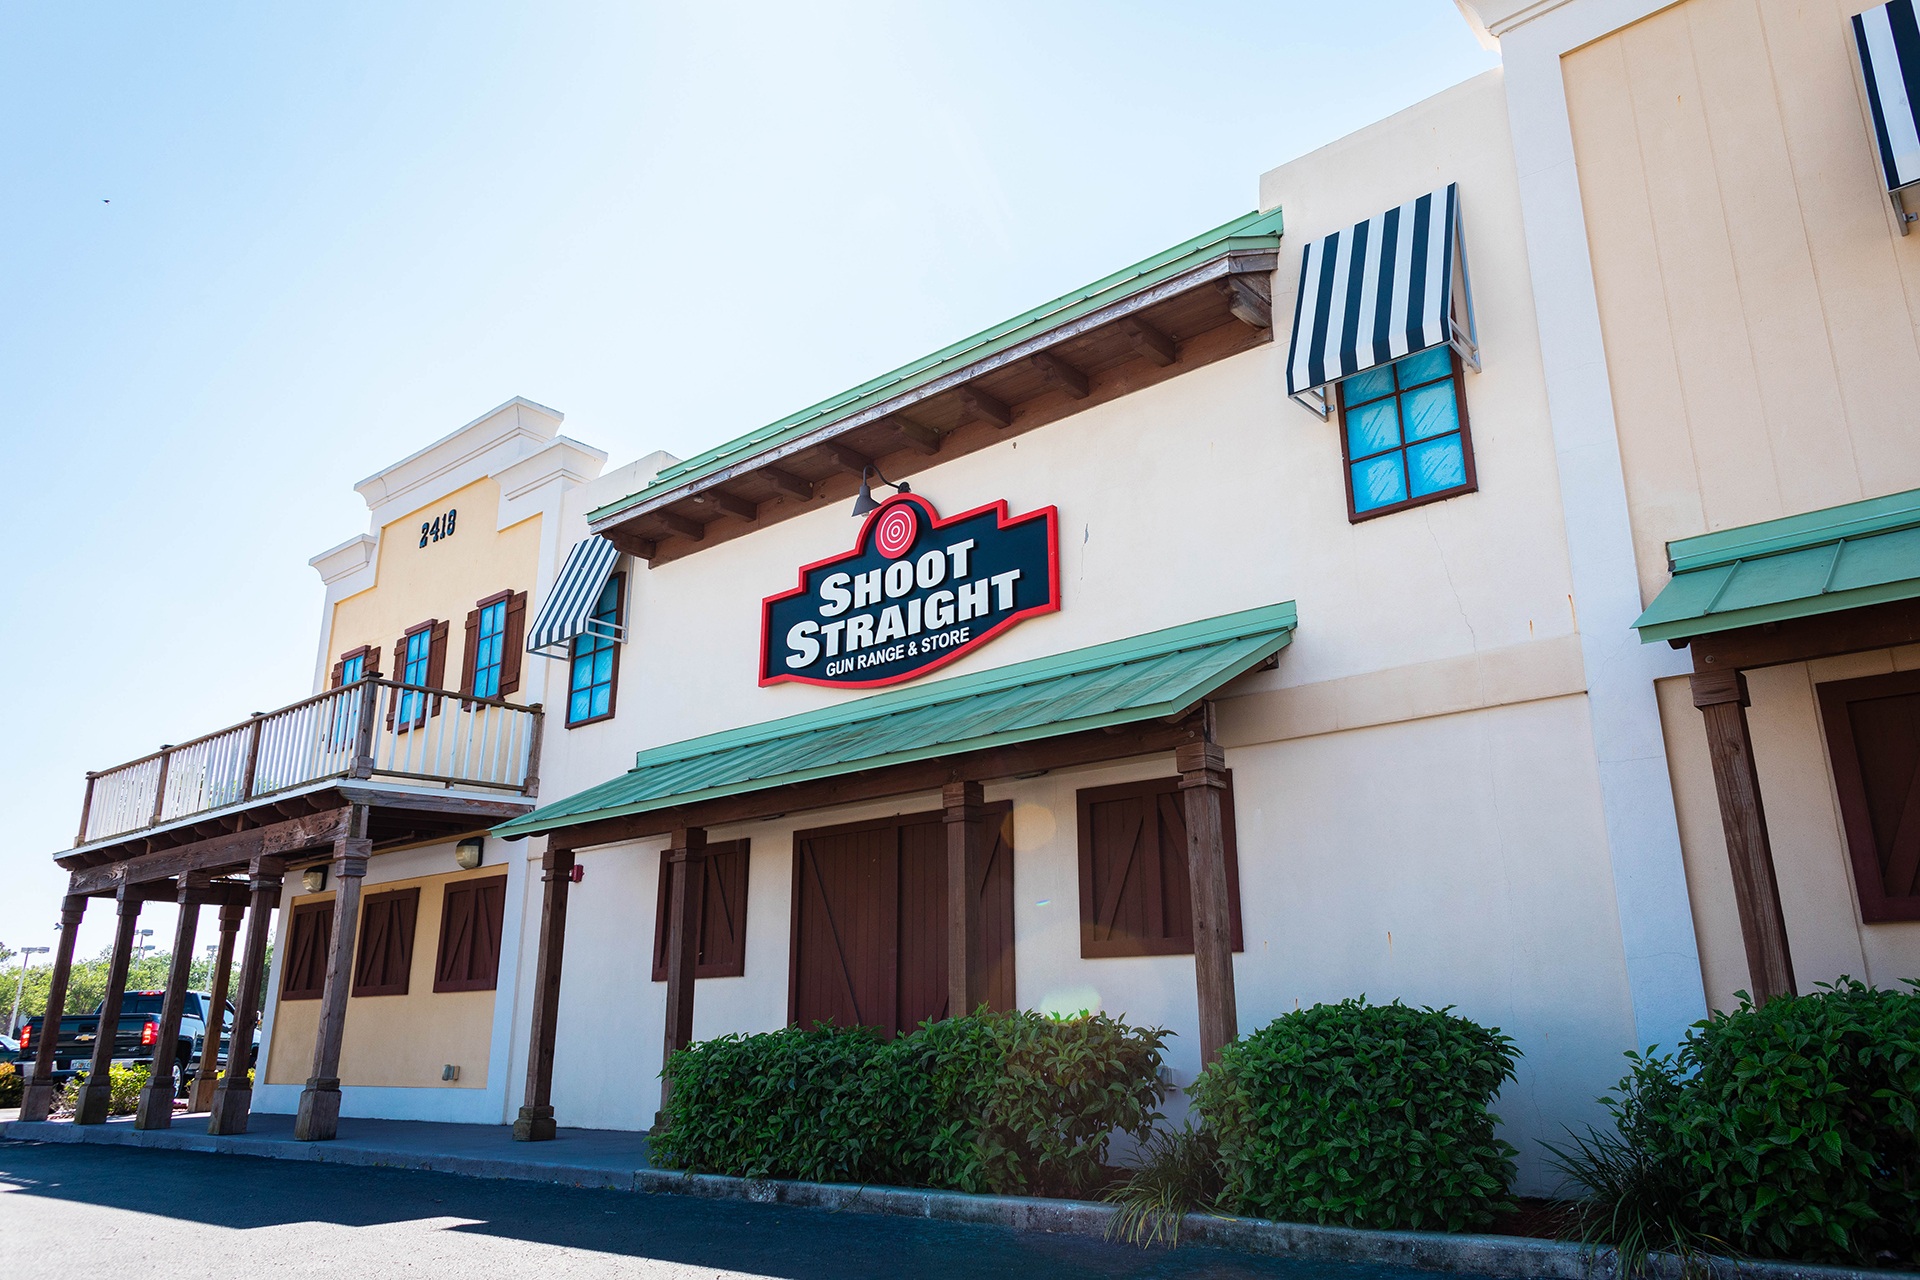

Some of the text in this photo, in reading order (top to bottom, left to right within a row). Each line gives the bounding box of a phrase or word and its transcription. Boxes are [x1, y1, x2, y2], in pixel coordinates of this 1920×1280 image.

[419, 509, 457, 549] 2418
[819, 538, 974, 617] SHOOT
[785, 569, 1020, 669] STRAIGHT
[826, 627, 970, 677] GUN RANGE & STORE
